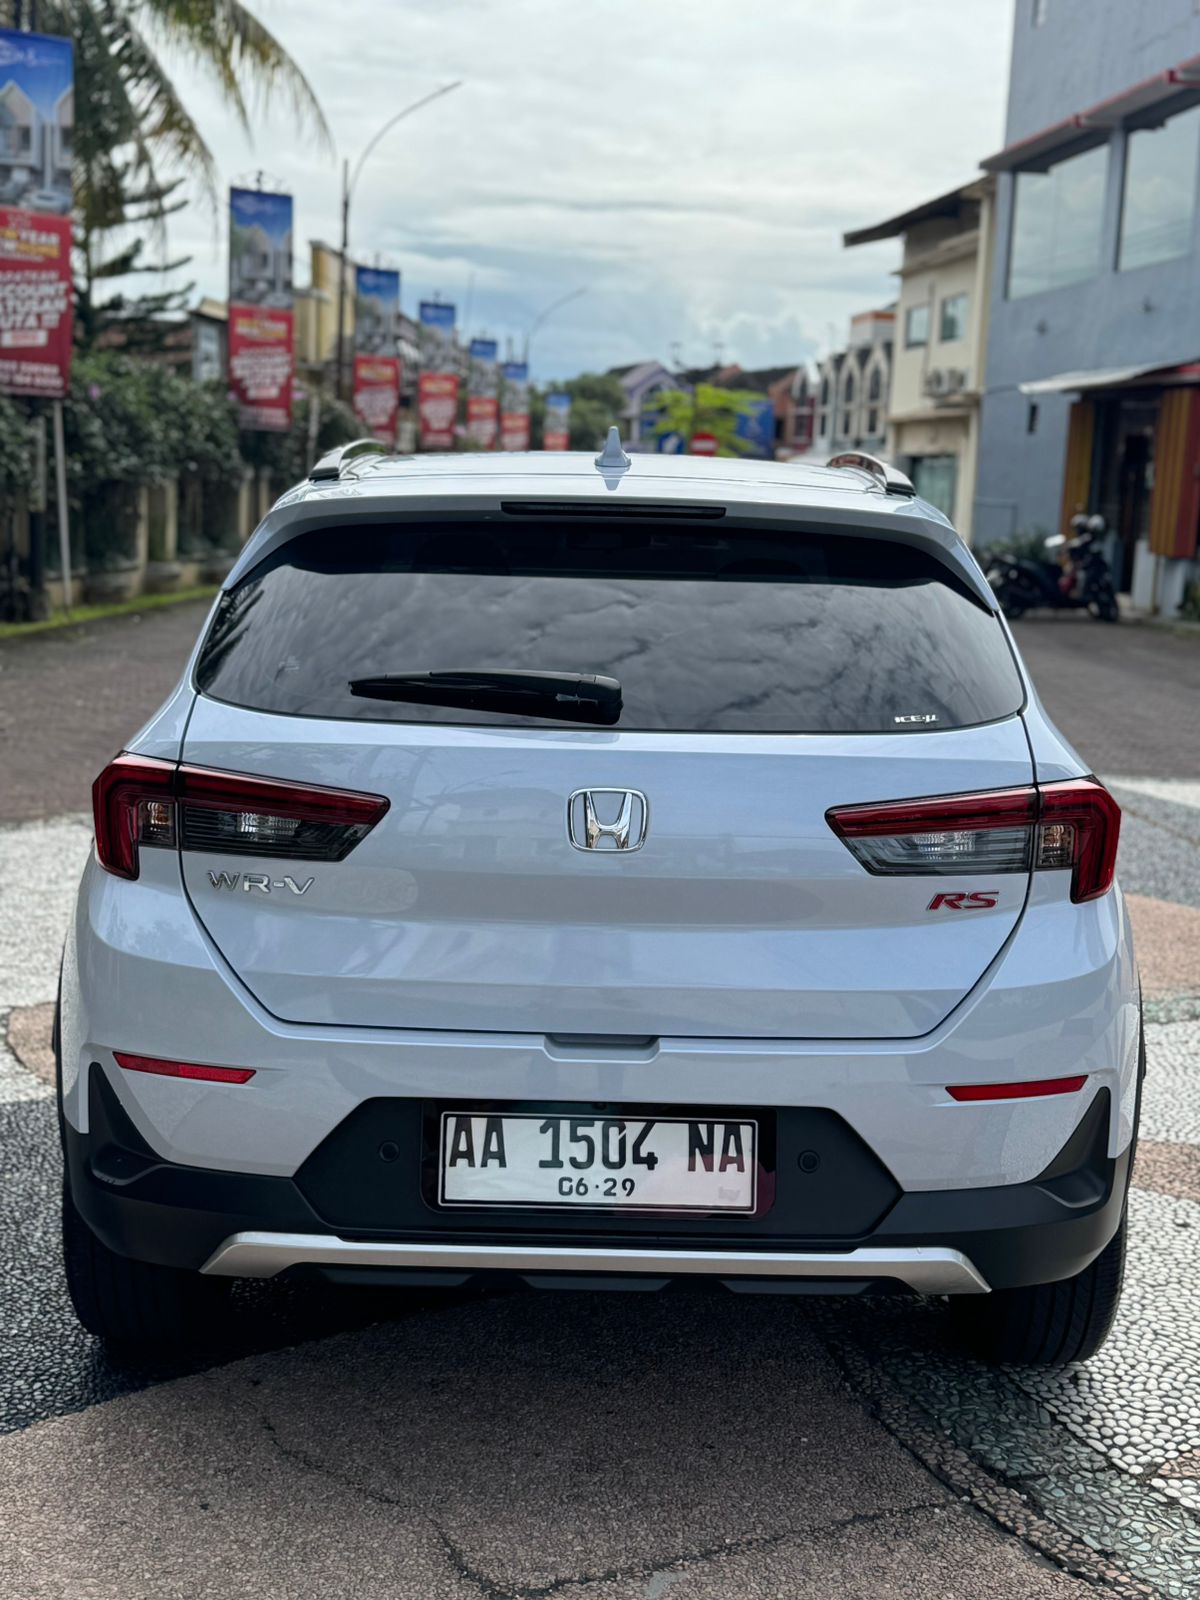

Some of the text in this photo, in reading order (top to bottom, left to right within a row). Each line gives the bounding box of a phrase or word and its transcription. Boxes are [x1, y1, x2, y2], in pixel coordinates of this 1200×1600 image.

[207, 870, 315, 896] WR-V
[926, 892, 1000, 911] RS
[449, 1117, 745, 1173] AA 1504 NA
